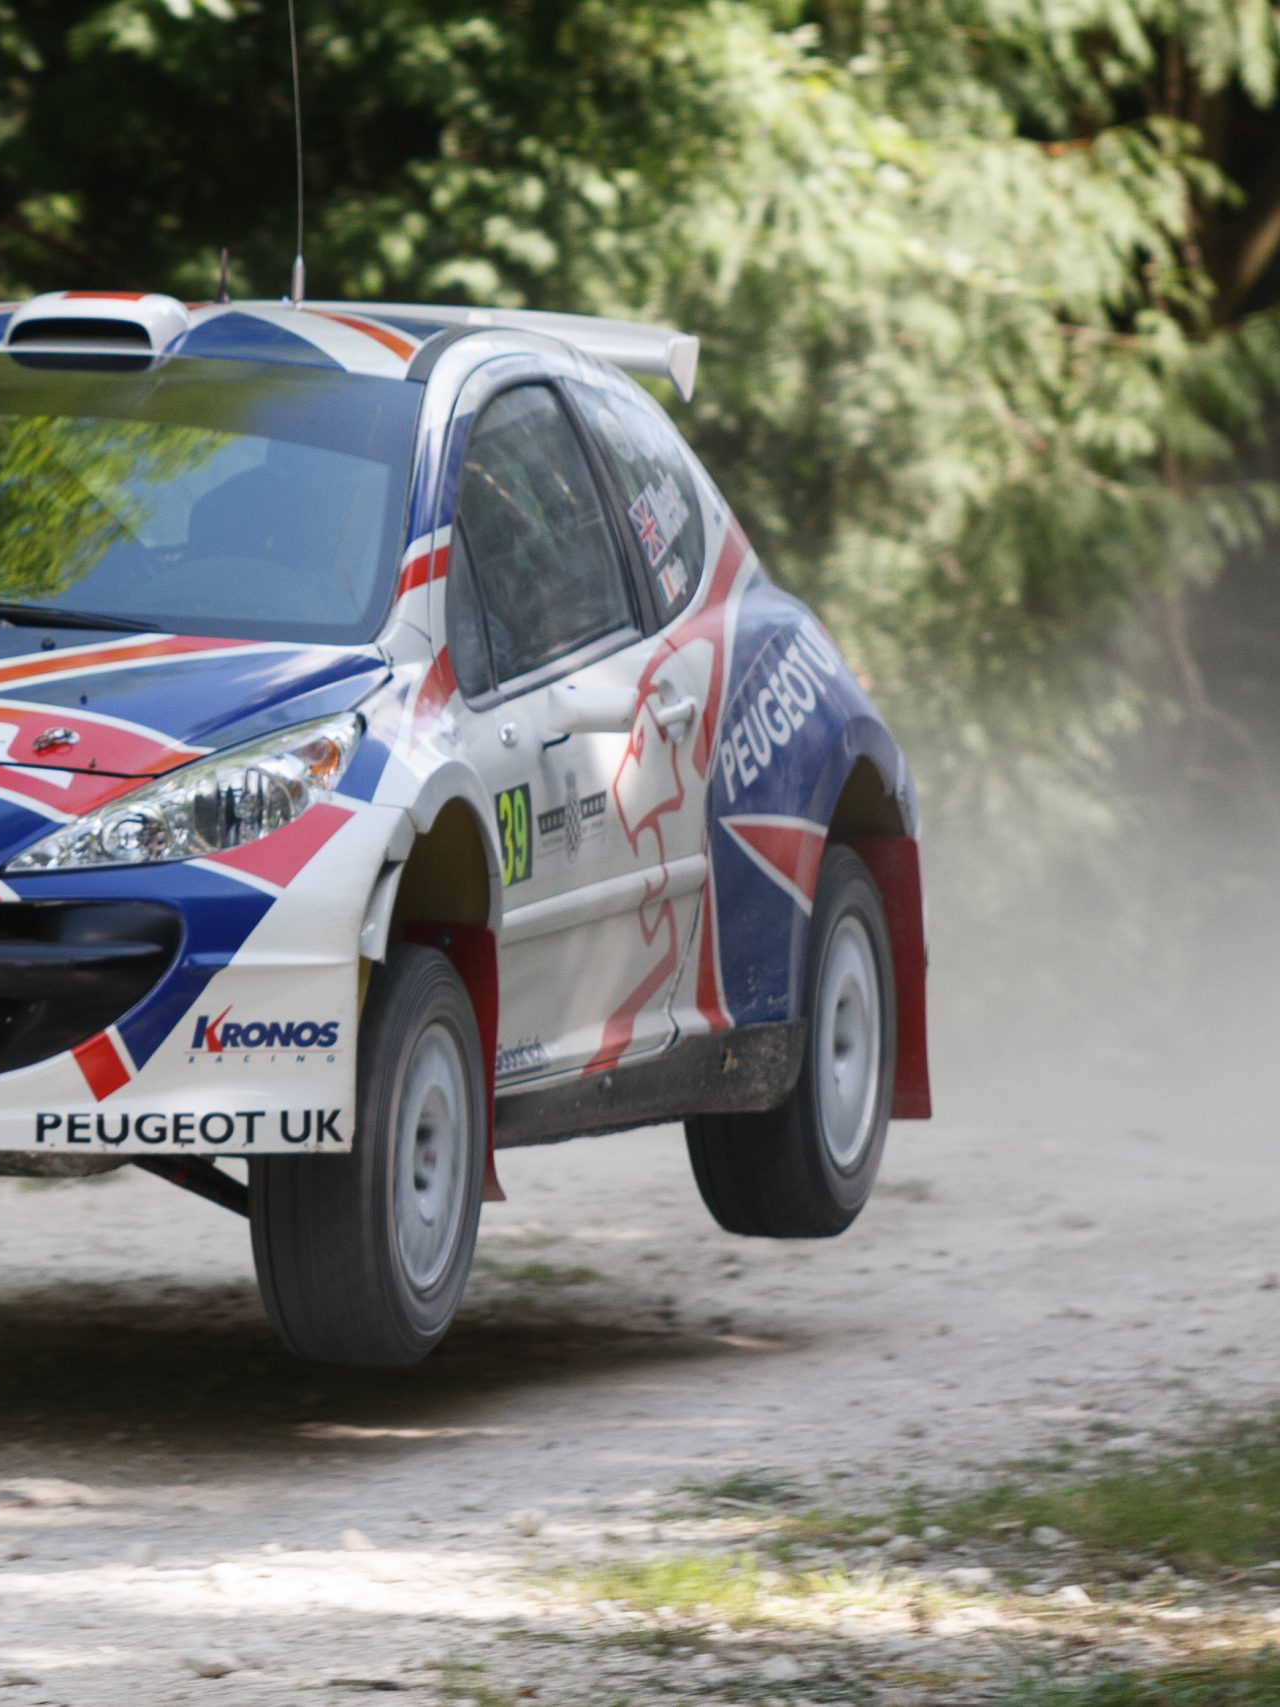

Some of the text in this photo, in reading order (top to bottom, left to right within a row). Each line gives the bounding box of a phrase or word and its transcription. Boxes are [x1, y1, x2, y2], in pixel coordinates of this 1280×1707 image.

[721, 642, 826, 804] PEUGEOT
[499, 787, 528, 888] 39
[191, 1003, 340, 1052] KRONOS
[188, 1054, 336, 1064] RACING
[36, 1109, 344, 1144] PEUGEOT UK
